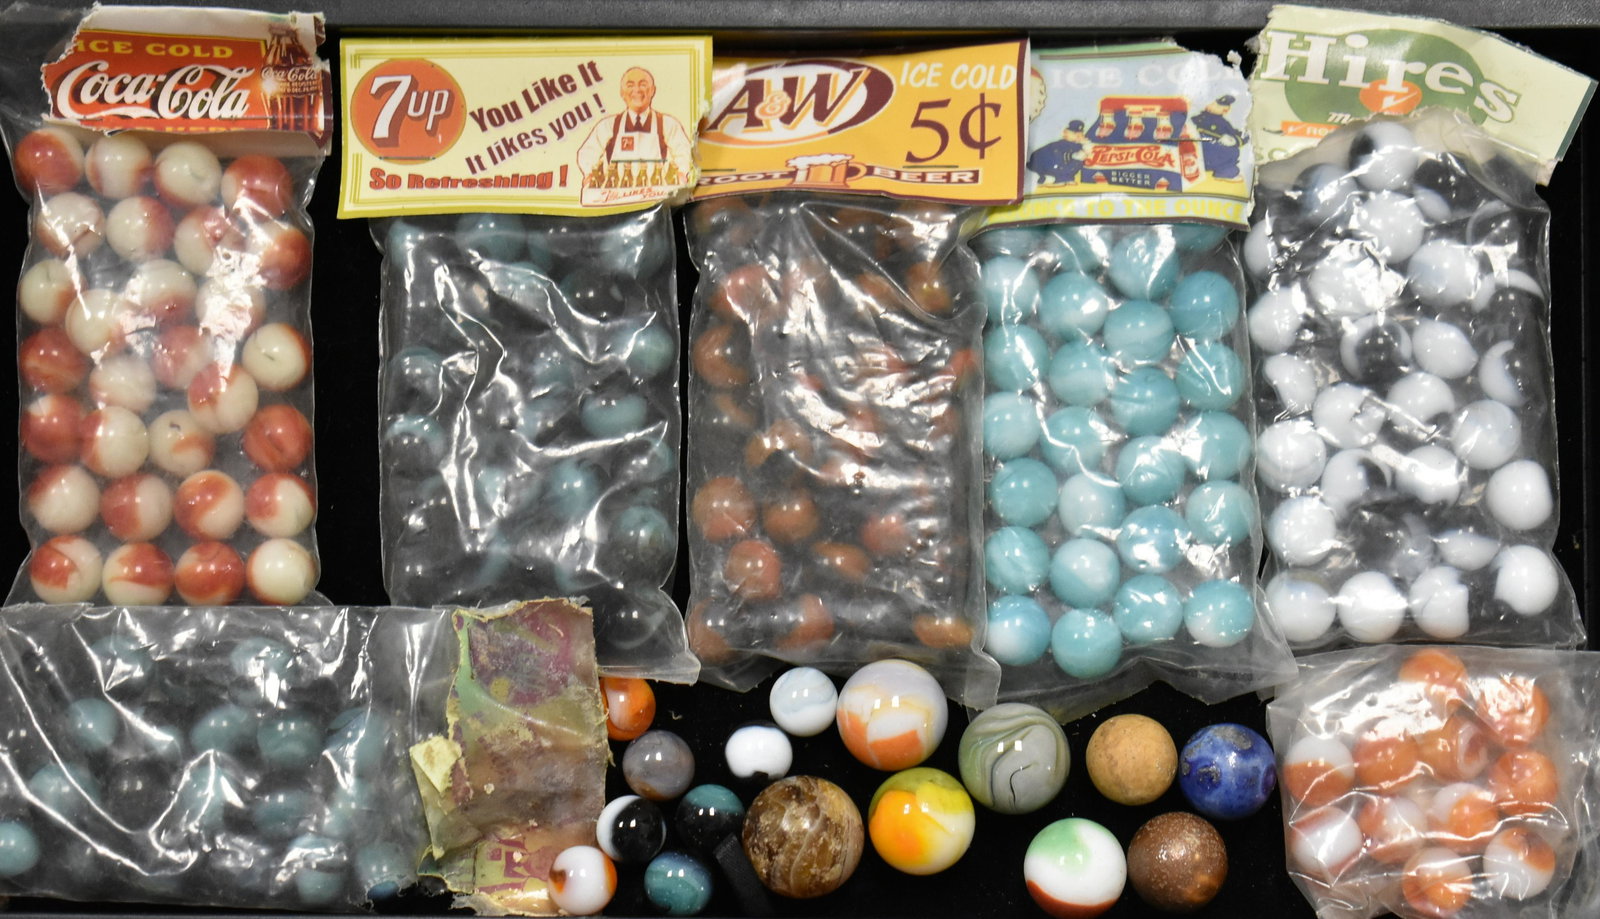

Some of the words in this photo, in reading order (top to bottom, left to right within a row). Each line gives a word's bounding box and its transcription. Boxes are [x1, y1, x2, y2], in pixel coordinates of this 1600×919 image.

[145, 42, 234, 59] COLD
[901, 61, 943, 87] ICE
[950, 62, 1017, 90] COLD
[1051, 66, 1122, 89] ICE
[1259, 29, 1519, 124] Hires
[56, 60, 255, 120] Coca-Cola
[469, 100, 523, 132] You
[521, 73, 578, 113] Like
[577, 60, 603, 87] It
[706, 67, 872, 134] A&W
[465, 154, 487, 175] It
[486, 127, 548, 166] likes
[548, 101, 593, 140] you
[904, 92, 1002, 164] 5¢
[369, 167, 402, 190] So
[407, 170, 554, 190] Refreshing
[873, 166, 975, 184] BEER
[1111, 170, 1151, 179] BIGGER
[1111, 177, 1151, 186] BETTER
[1086, 198, 1114, 217] TO
[1122, 198, 1167, 217] THE
[1174, 198, 1243, 222] OUNCE
